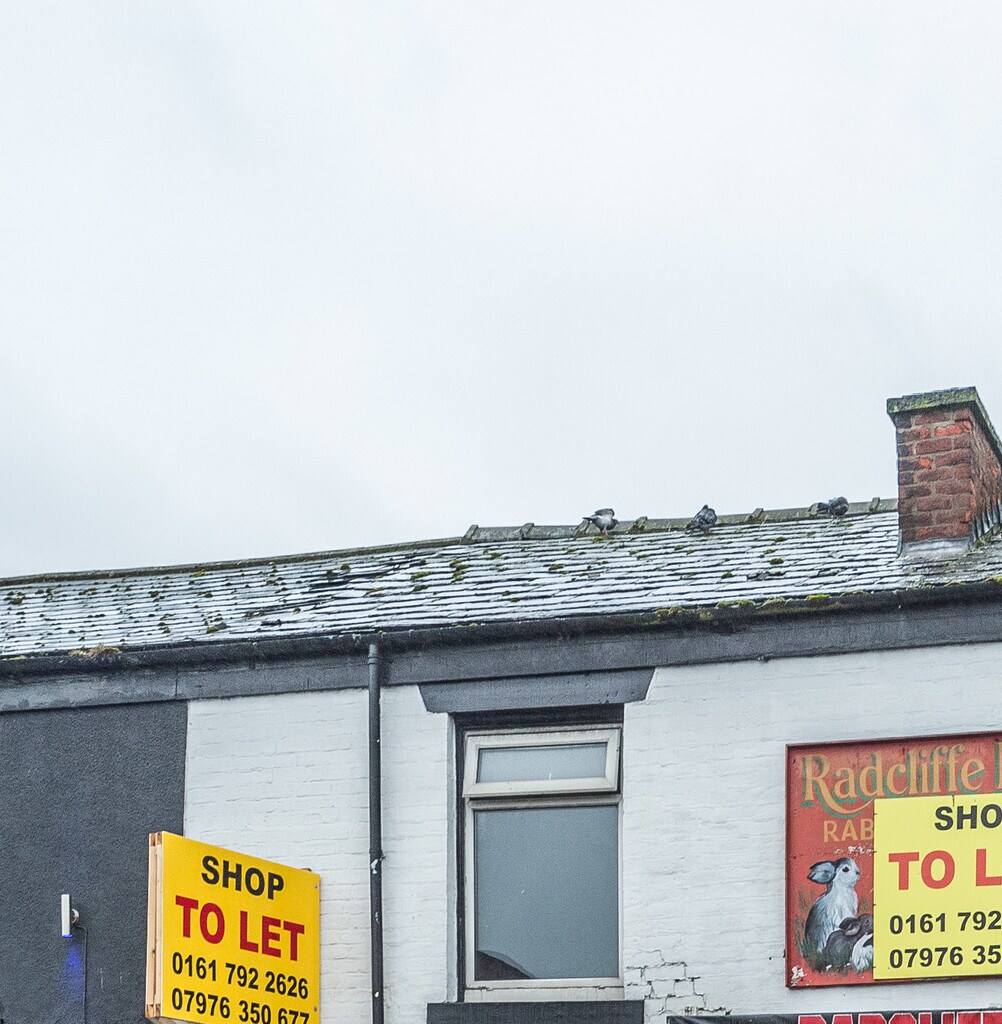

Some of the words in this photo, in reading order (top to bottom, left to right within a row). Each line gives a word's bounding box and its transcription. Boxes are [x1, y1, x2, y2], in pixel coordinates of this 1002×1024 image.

[802, 744, 985, 817] Radcliffe
[201, 855, 284, 900] SHOP
[888, 850, 955, 891] TO
[175, 895, 225, 944] TO
[240, 911, 305, 961] LET
[889, 912, 946, 934] 0161
[957, 910, 1001, 931] 792
[172, 952, 216, 981] 0161
[225, 963, 259, 989] 792
[265, 971, 308, 999] 2626
[889, 946, 963, 968] 07976
[172, 988, 230, 1018] 07976
